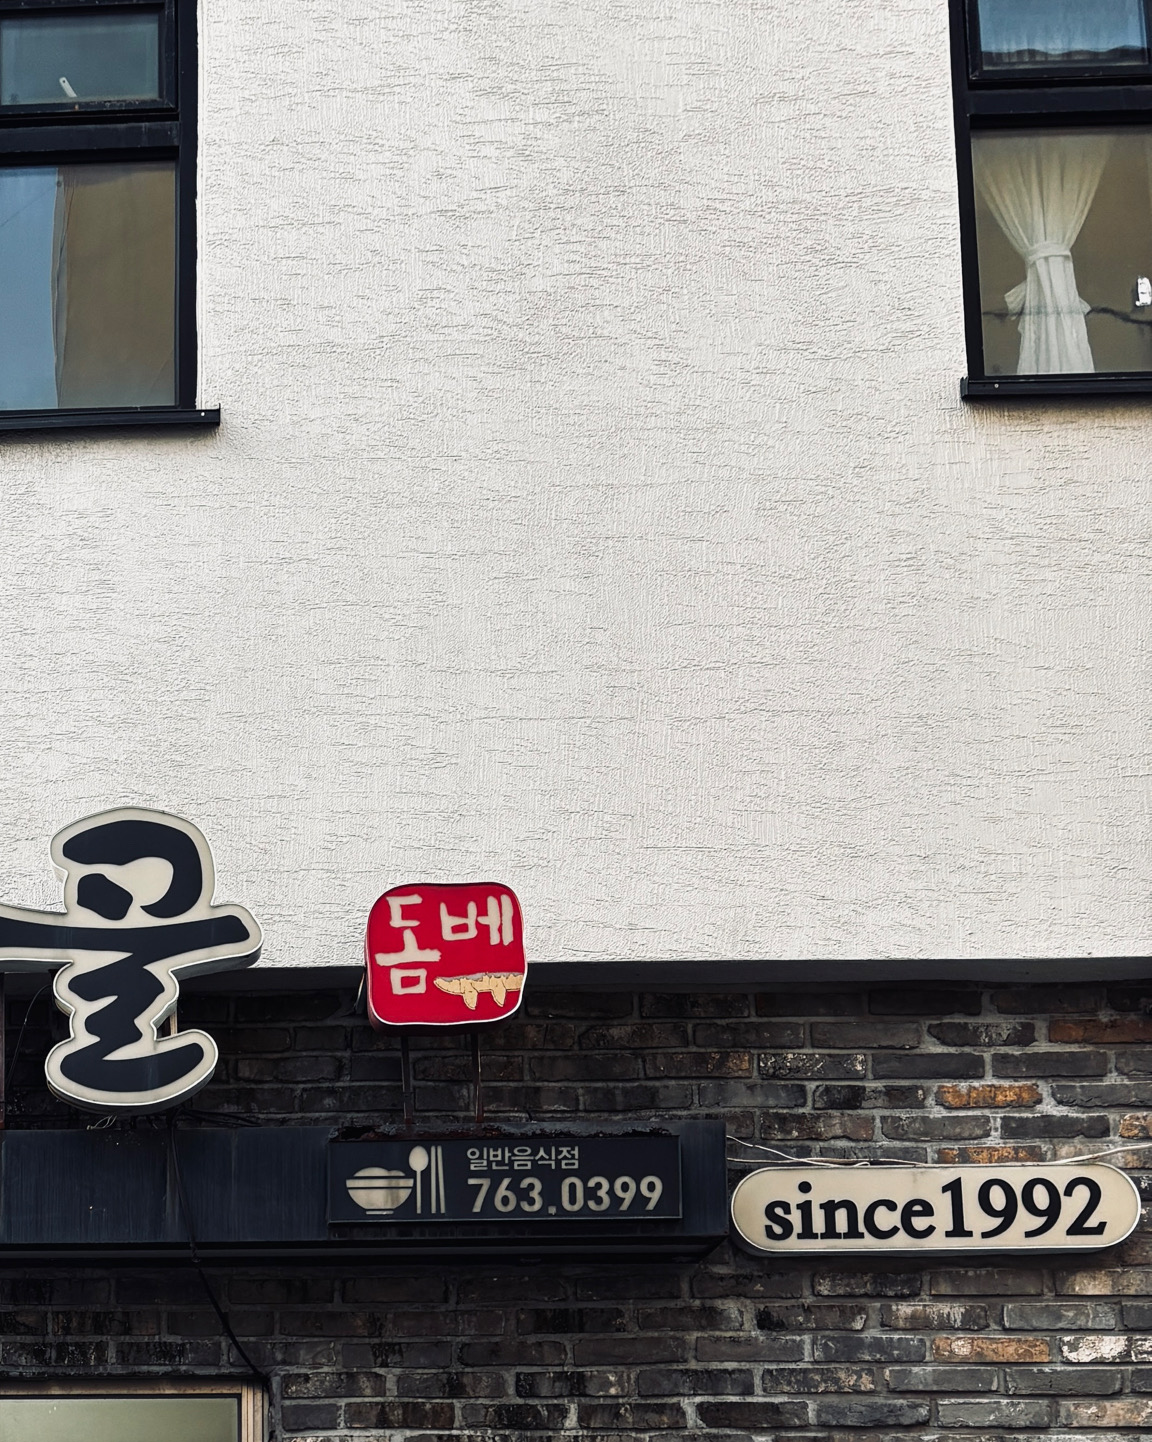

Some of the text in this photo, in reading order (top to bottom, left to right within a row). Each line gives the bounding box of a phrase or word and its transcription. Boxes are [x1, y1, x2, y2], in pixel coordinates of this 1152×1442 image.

[374, 893, 515, 996] 돔베
[466, 1146, 580, 1170] 일반음식점
[467, 1175, 663, 1216] 763.0399
